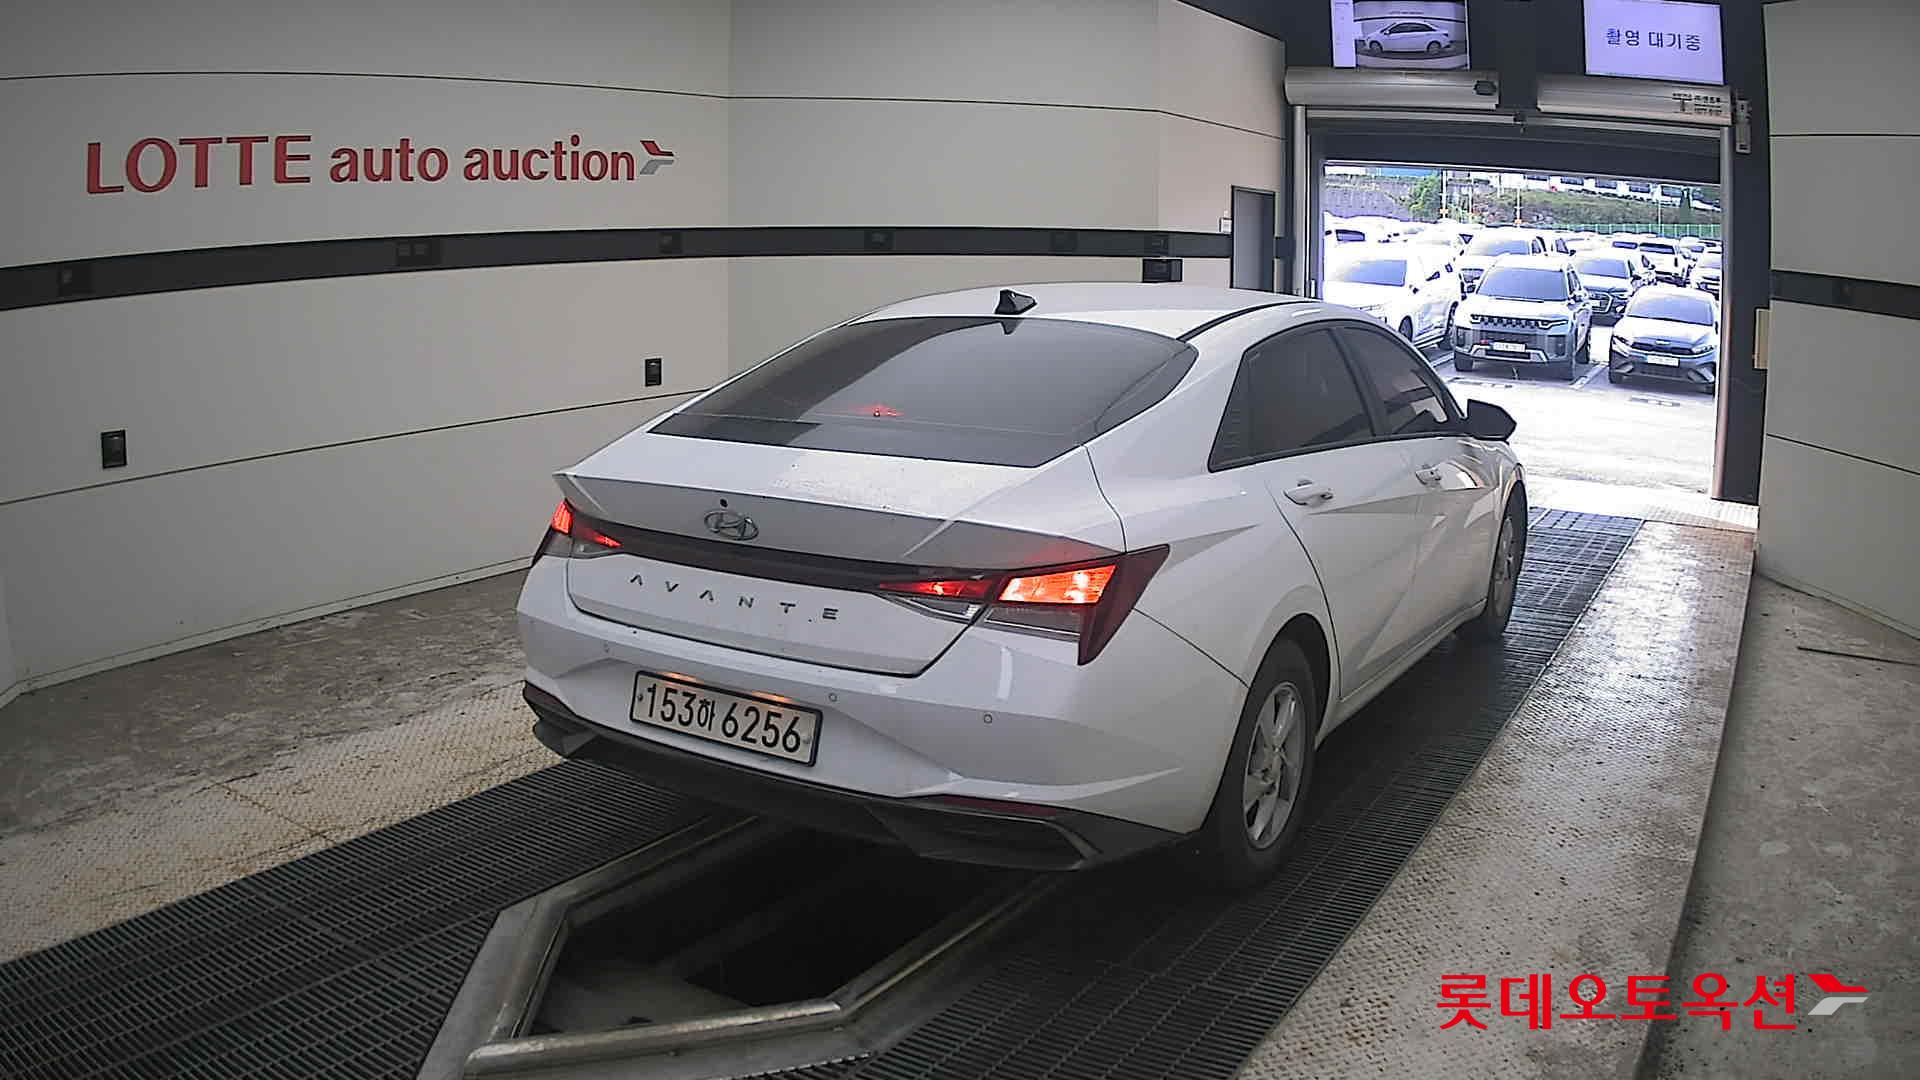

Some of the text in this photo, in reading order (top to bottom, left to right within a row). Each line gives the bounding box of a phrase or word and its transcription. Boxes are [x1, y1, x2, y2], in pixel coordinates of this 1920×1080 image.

[1607, 28, 1701, 51] 촬영 대기중
[86, 134, 635, 194] LOTTE auto auction
[630, 574, 839, 620] AVANTE
